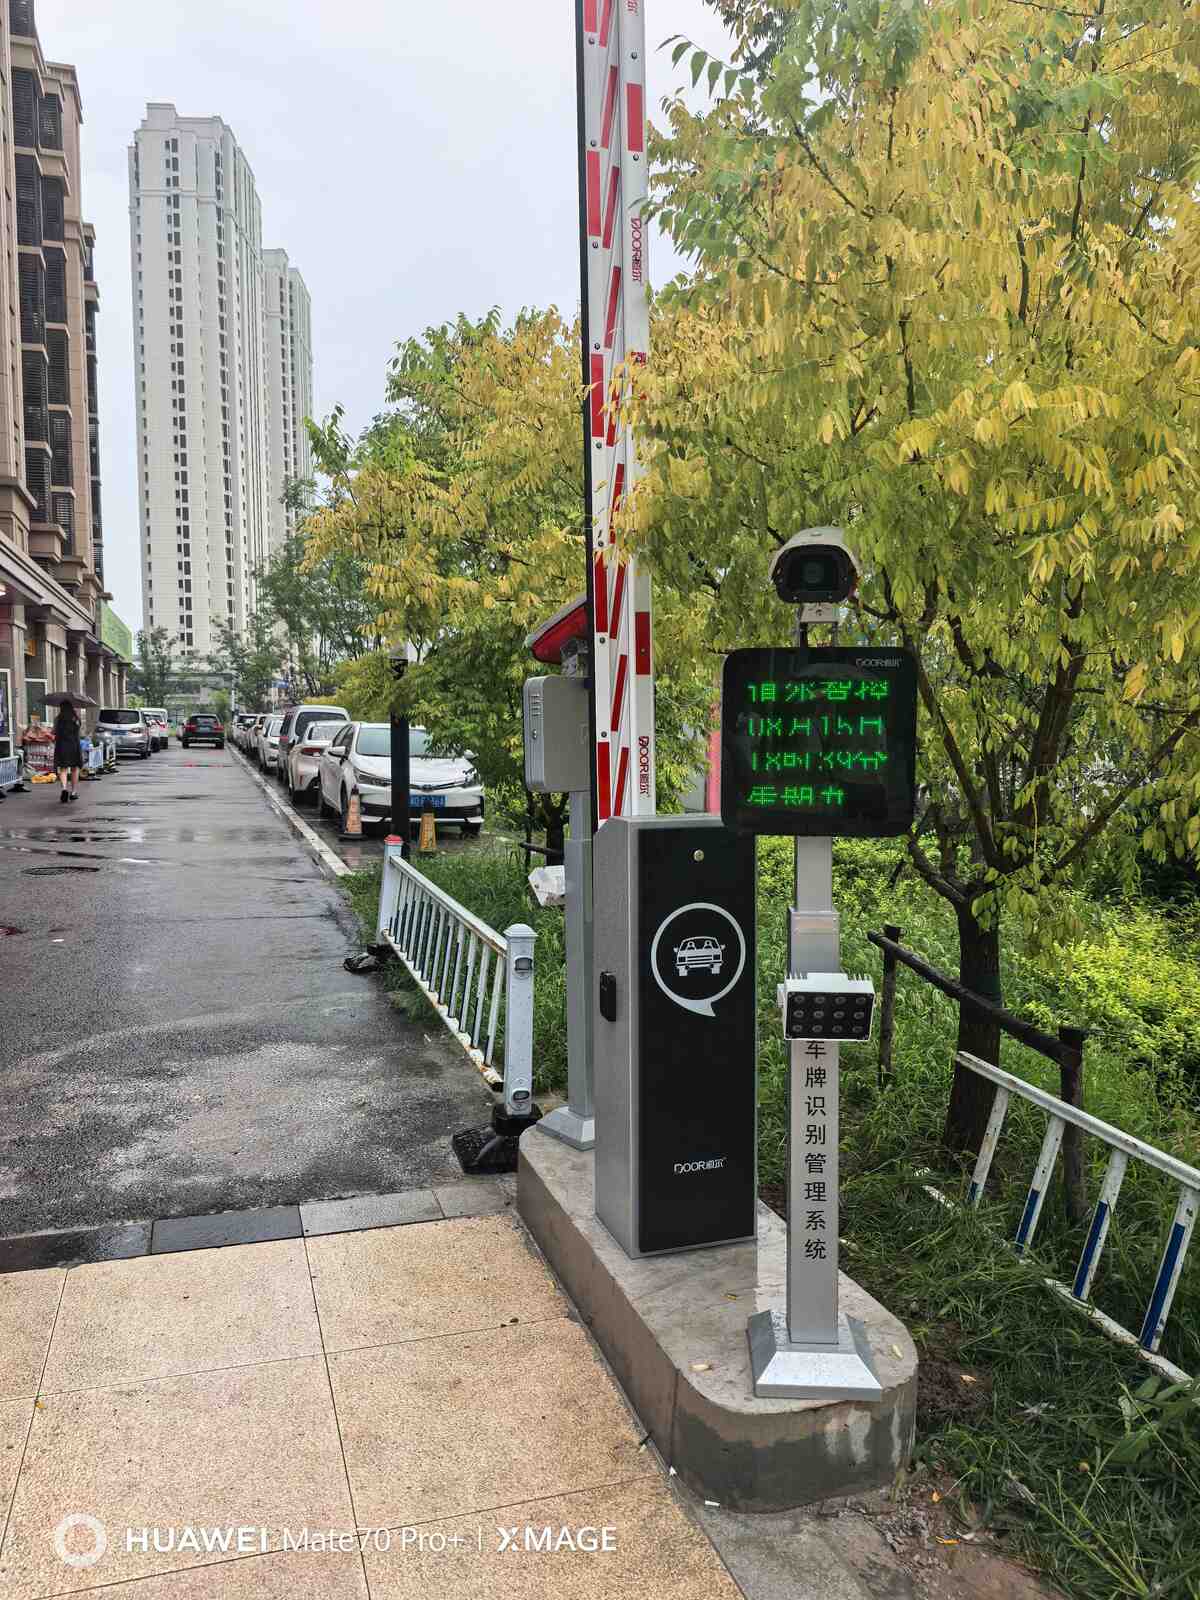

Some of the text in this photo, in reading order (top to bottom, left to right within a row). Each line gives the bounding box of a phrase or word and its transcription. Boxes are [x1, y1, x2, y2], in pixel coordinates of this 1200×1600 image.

[804, 1040, 827, 1260] 车牌识别管理系统
